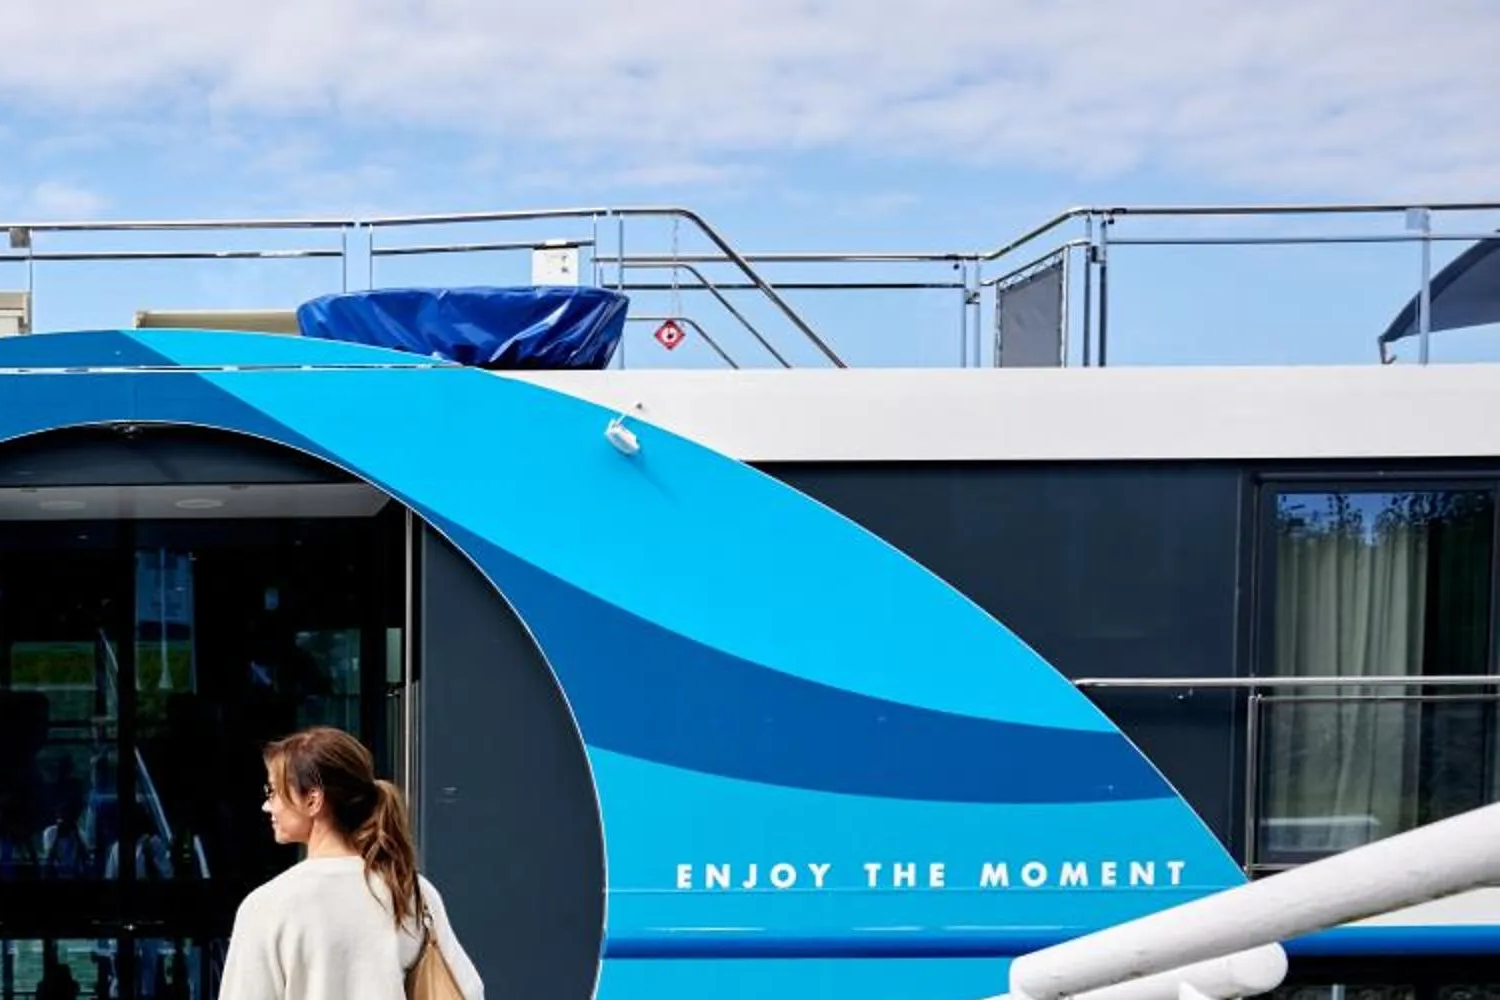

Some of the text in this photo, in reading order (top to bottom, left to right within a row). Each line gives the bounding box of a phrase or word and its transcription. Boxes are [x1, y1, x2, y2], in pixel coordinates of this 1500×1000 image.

[676, 860, 1185, 889] ENJOY THE MOMENT
